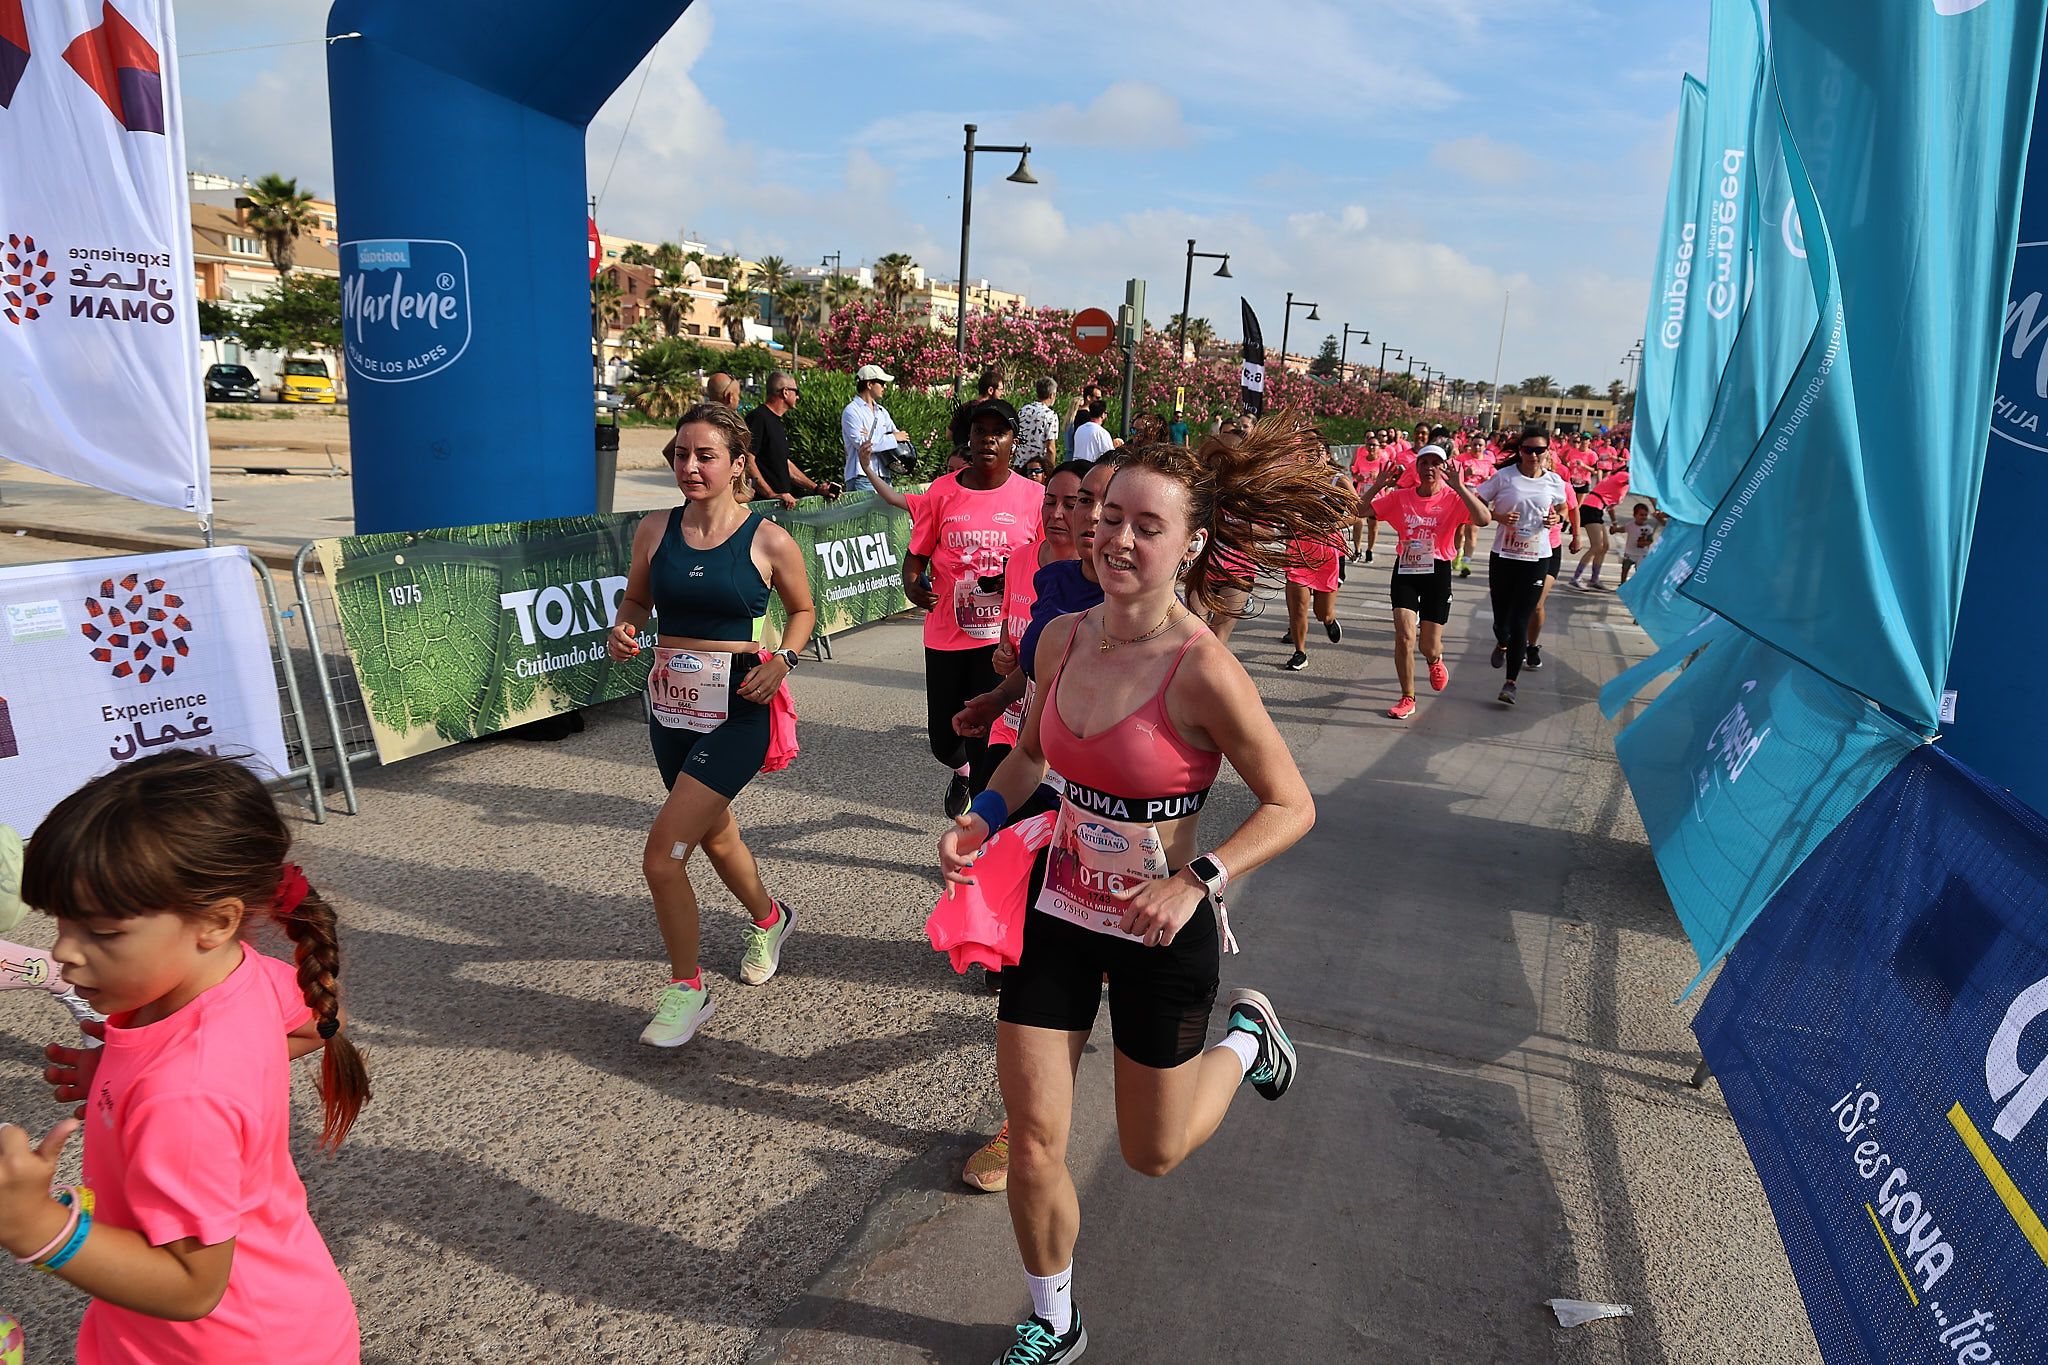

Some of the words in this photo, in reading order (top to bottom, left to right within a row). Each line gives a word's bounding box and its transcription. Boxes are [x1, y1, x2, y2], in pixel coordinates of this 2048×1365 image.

[344, 271, 458, 344] Marlene
[364, 358, 378, 371] DE
[380, 360, 403, 373] LOS
[407, 344, 448, 371] ALPES
[948, 530, 1008, 548] CARRERA
[1514, 541, 1529, 549] 016
[388, 584, 422, 606] 1975
[857, 580, 865, 594] de
[871, 574, 888, 589] desde
[888, 573, 902, 586] 1975
[976, 605, 1001, 617] 016
[516, 645, 585, 679] Cuidando
[589, 642, 605, 662] de
[669, 686, 699, 701] 016
[101, 693, 207, 722] Experience
[1070, 783, 1130, 819] PUMA
[1146, 794, 1200, 819] PUM
[1078, 827, 1126, 851] ASTURIANA
[1079, 865, 1125, 894] 016
[1053, 897, 1089, 921] OYSHO
[1089, 891, 1112, 904] 1743
[1095, 903, 1117, 914] MUJER
[1854, 1140, 1891, 1179] es
[1878, 1167, 1954, 1293] GOYA
